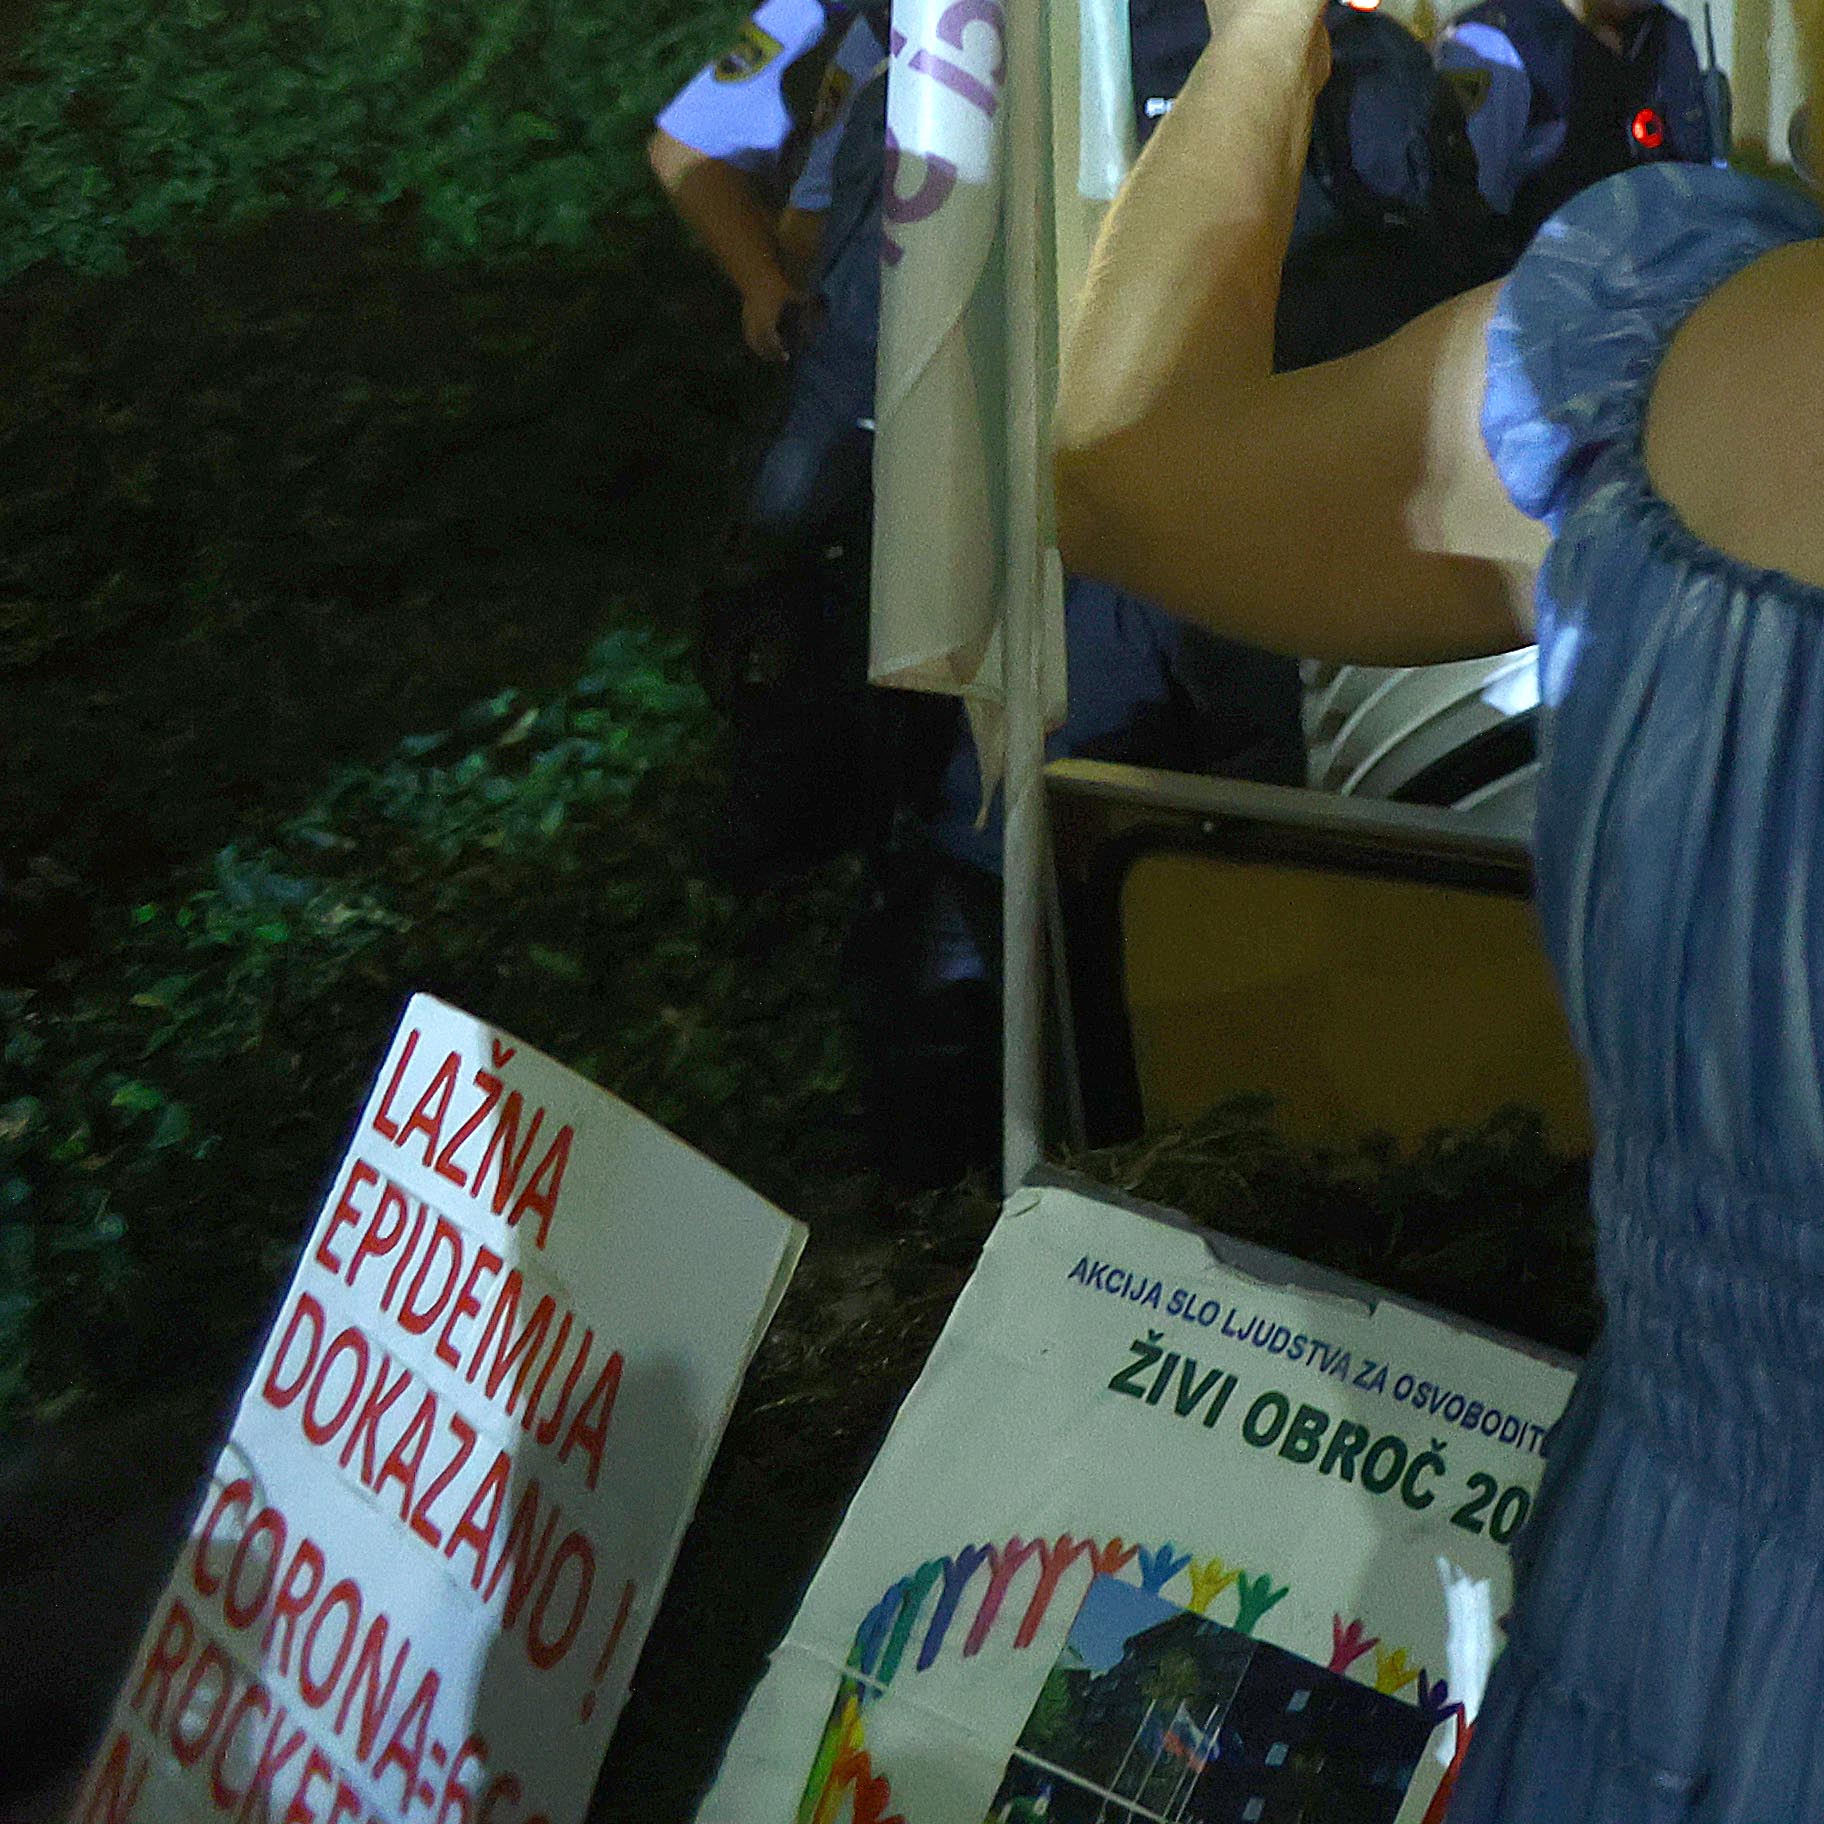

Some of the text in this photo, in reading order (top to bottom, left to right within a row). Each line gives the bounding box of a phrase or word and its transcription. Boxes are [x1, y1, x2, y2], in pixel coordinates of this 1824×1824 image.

[373, 1029, 576, 1250] LAŽNA
[316, 1158, 625, 1491] EPIDEMIJA
[1068, 1256, 1161, 1309] AKCIJA
[1167, 1289, 1219, 1327] SLO
[1220, 1308, 1351, 1382] LJUDSTVA
[1353, 1359, 1390, 1395] ZA
[262, 1292, 596, 1670] DOKAZANO
[1107, 1329, 1532, 1545] ŽIVI OBROČ 20
